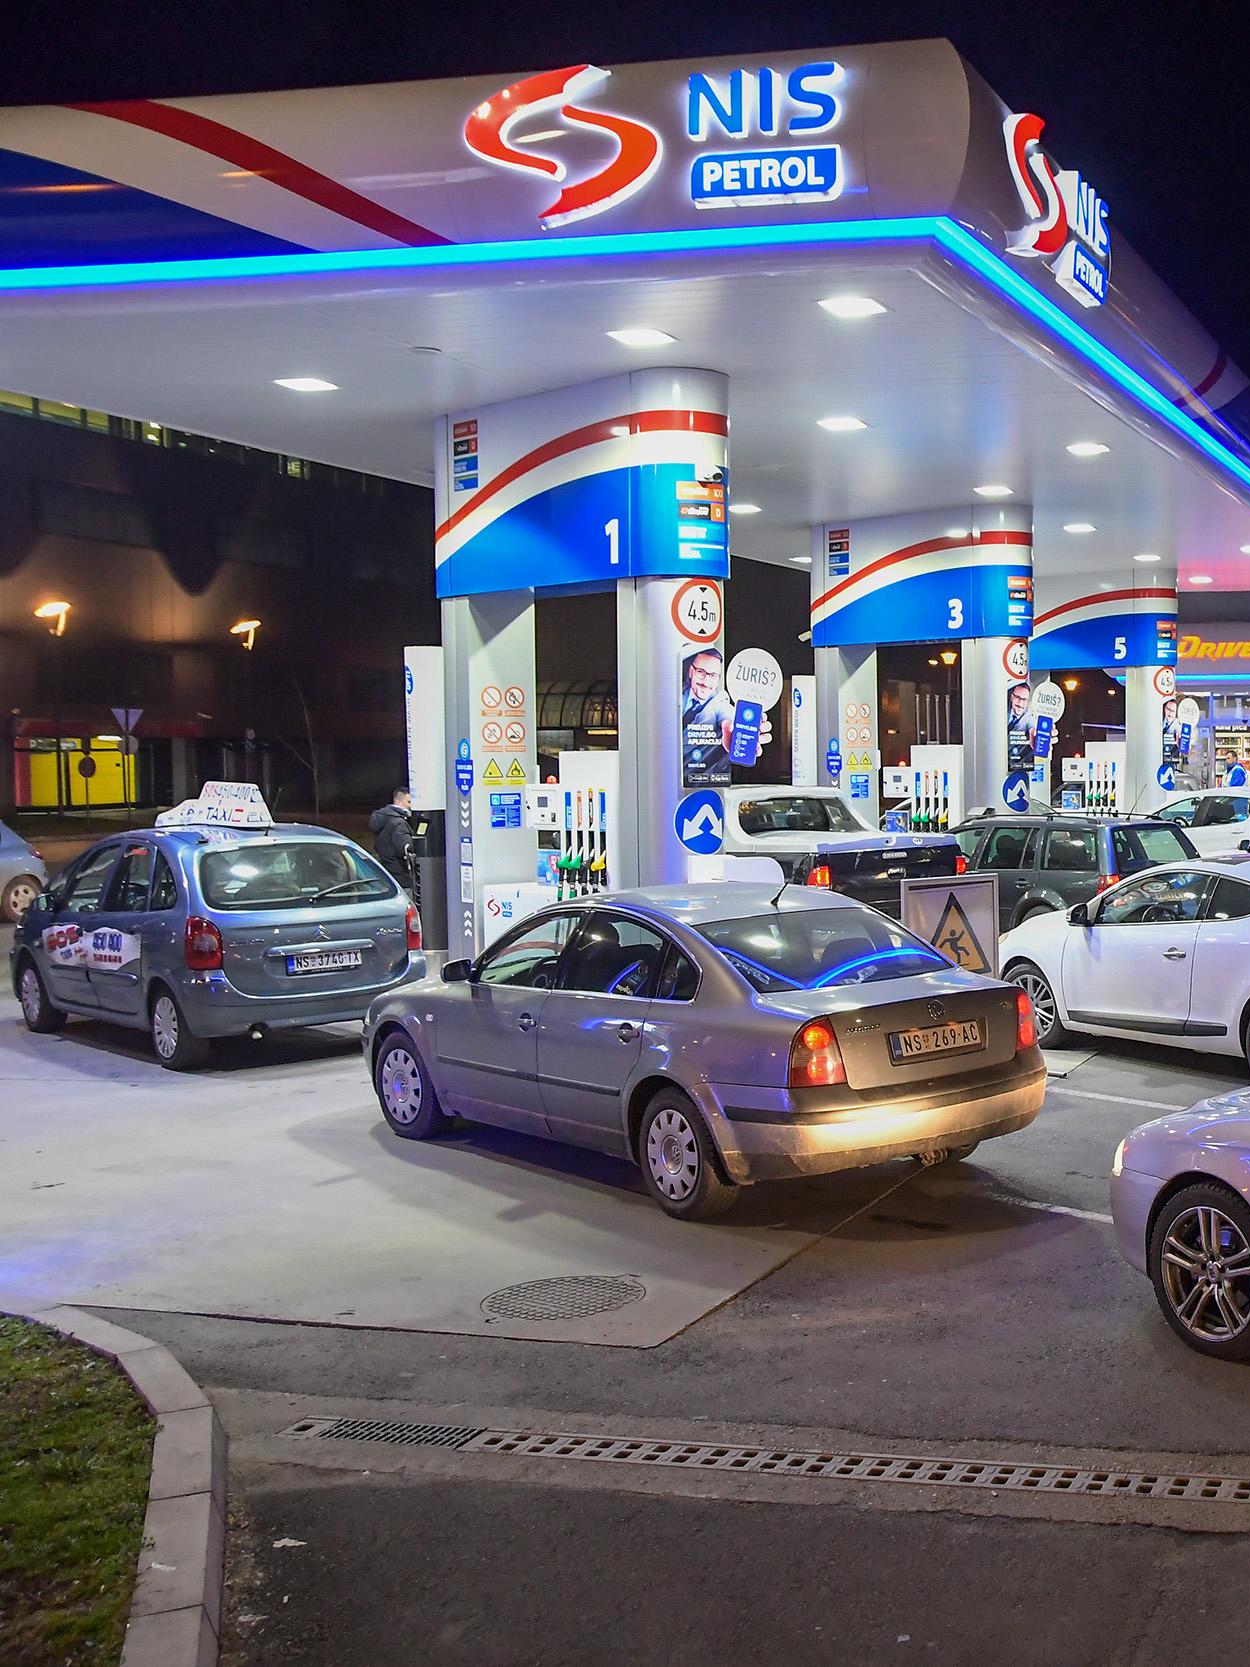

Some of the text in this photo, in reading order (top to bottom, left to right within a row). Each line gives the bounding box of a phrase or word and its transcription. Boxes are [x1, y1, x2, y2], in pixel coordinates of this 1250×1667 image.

[687, 61, 842, 140] NIS
[702, 155, 826, 193] PETROL
[1075, 172, 1111, 257] NIS
[1075, 250, 1104, 299] PETROL
[715, 508, 722, 518] D
[604, 518, 619, 565] 1
[947, 598, 964, 629] 3
[1114, 637, 1127, 660] 5
[735, 661, 777, 687] ŽURIŠ?
[1037, 691, 1061, 708] ŽURIŠ?
[206, 807, 233, 822] TAXI
[501, 901, 513, 911] NIS
[295, 955, 311, 970] NS
[903, 1034, 922, 1054] NS
